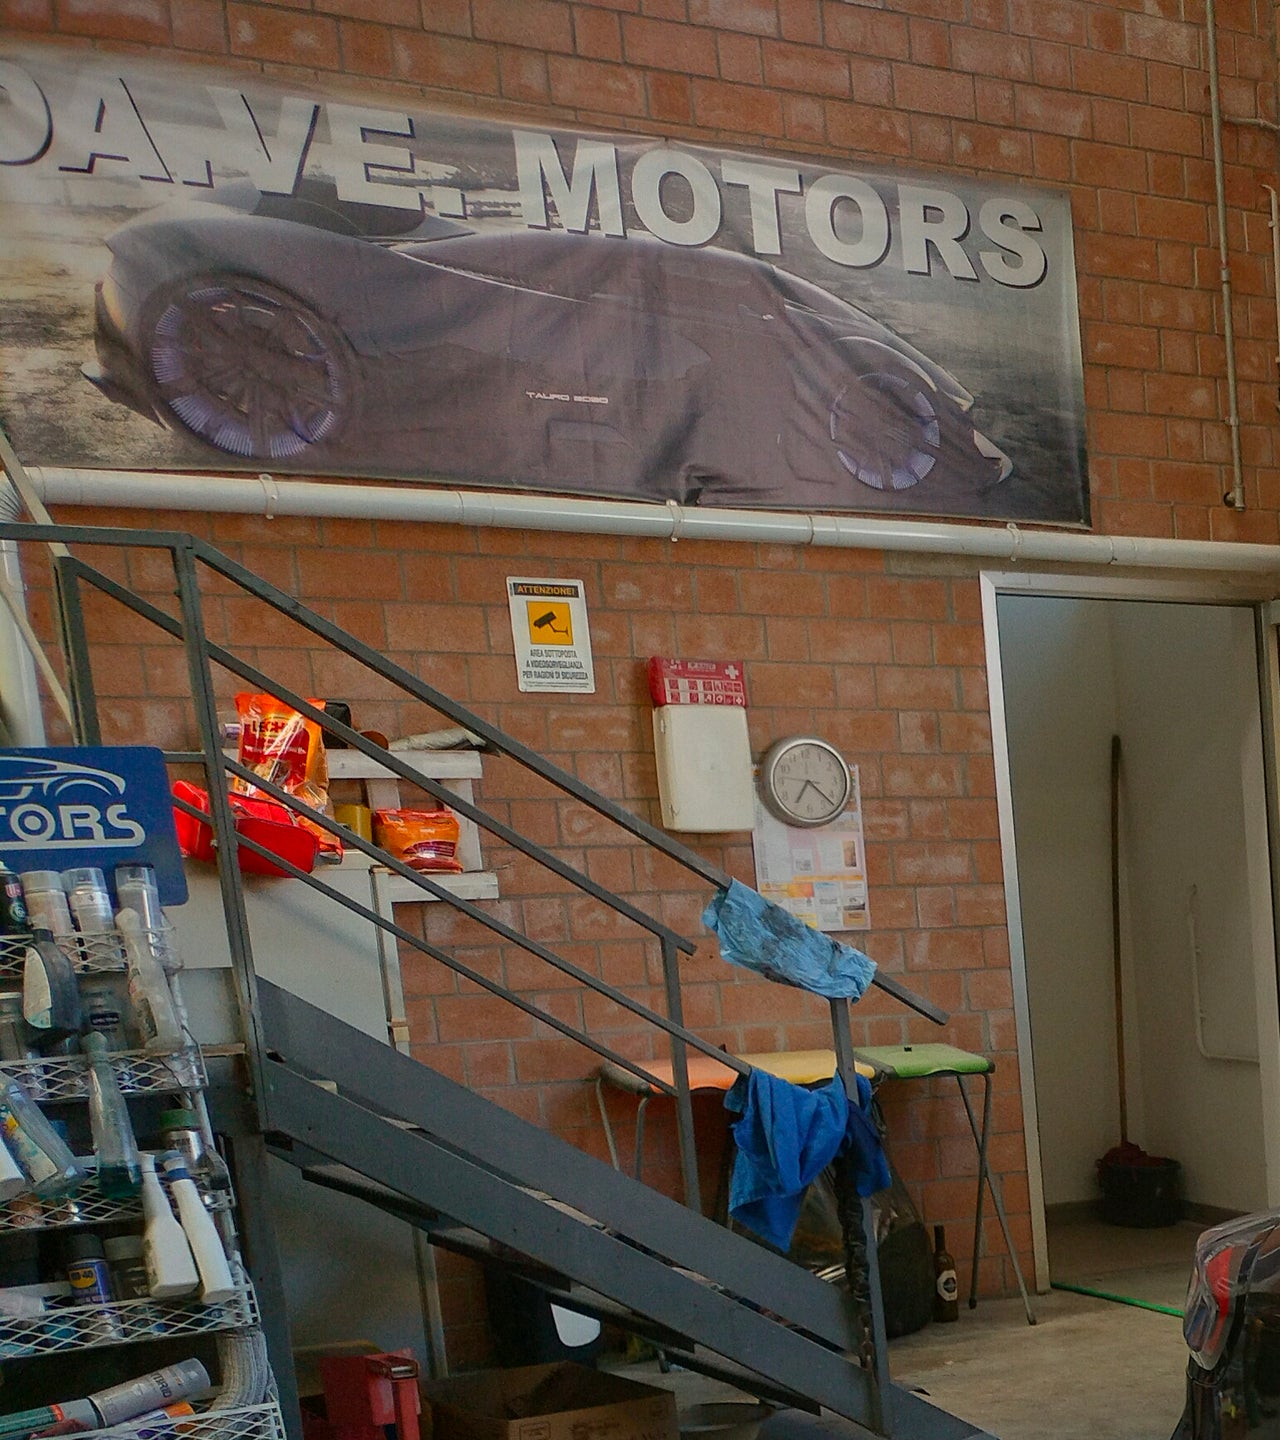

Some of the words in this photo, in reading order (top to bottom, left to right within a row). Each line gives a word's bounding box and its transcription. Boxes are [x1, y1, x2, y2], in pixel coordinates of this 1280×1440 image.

[512, 130, 1049, 289] MOTORS
[525, 390, 570, 402] TAURO
[517, 585, 577, 596] ATTENZIONE!
[530, 649, 544, 658] AREA
[526, 660, 531, 668] A
[522, 670, 533, 679] PER
[0, 802, 146, 848] ORS
